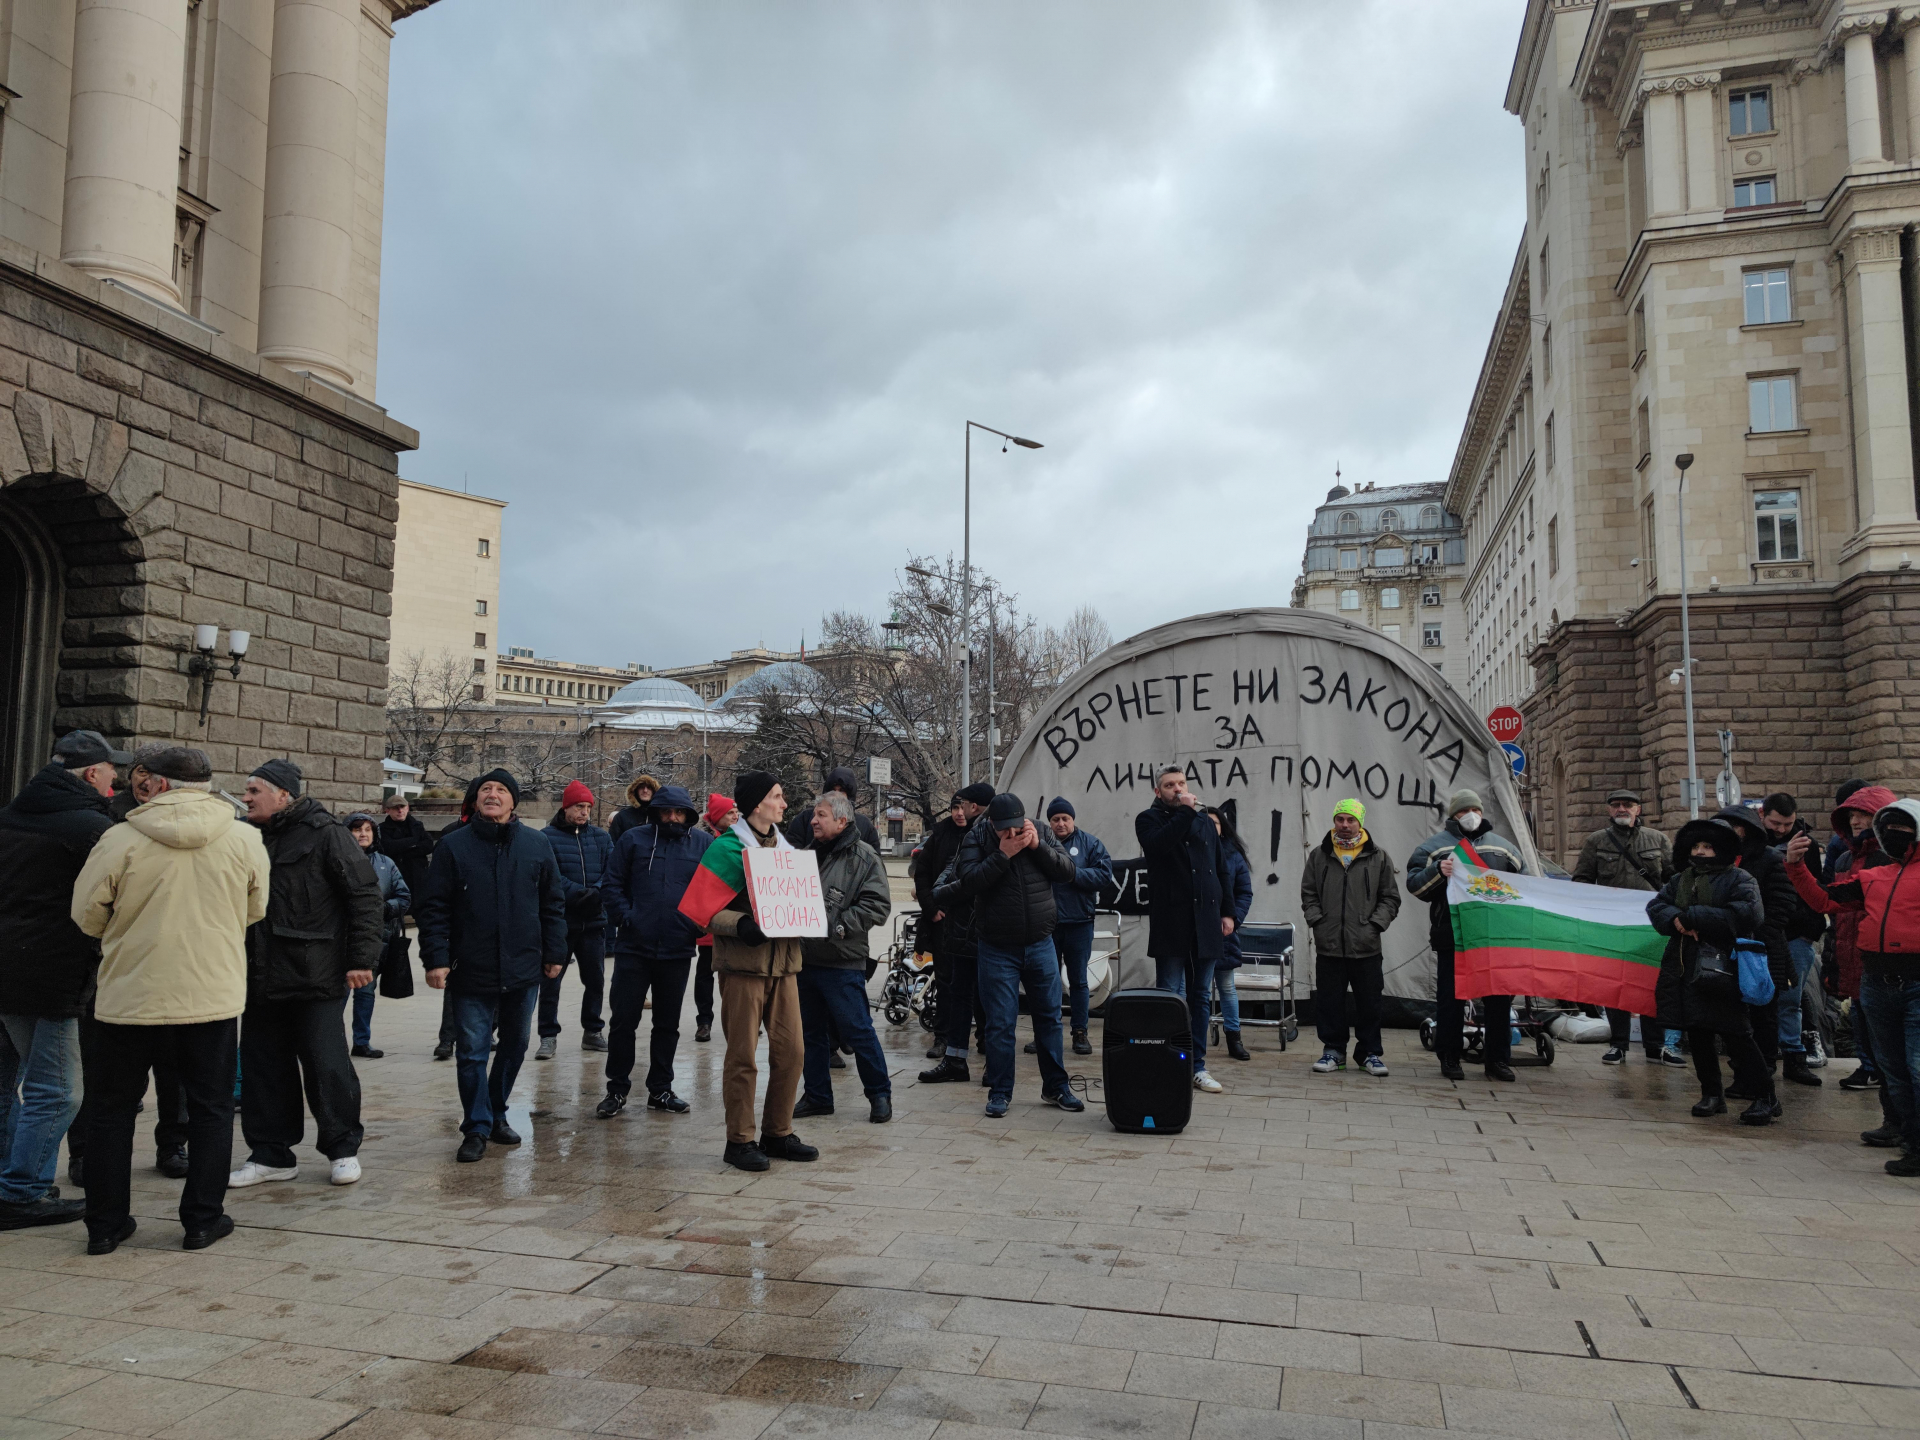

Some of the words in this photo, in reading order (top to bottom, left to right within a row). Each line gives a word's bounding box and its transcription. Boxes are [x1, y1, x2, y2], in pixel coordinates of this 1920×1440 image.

[1043, 672, 1214, 768] ВЪРНЕТЕ
[1232, 667, 1279, 705] НИ
[1299, 665, 1464, 786] ЗАКОНА
[1214, 713, 1265, 749] ЗА
[1490, 717, 1519, 731] STOP
[1086, 756, 1249, 793] ЛИЧАТА
[1270, 755, 1445, 822] ПОМОЩ
[773, 850, 795, 869] НЕ
[757, 875, 819, 899] ИСКАМЕ
[761, 901, 821, 930] ВОЙНА
